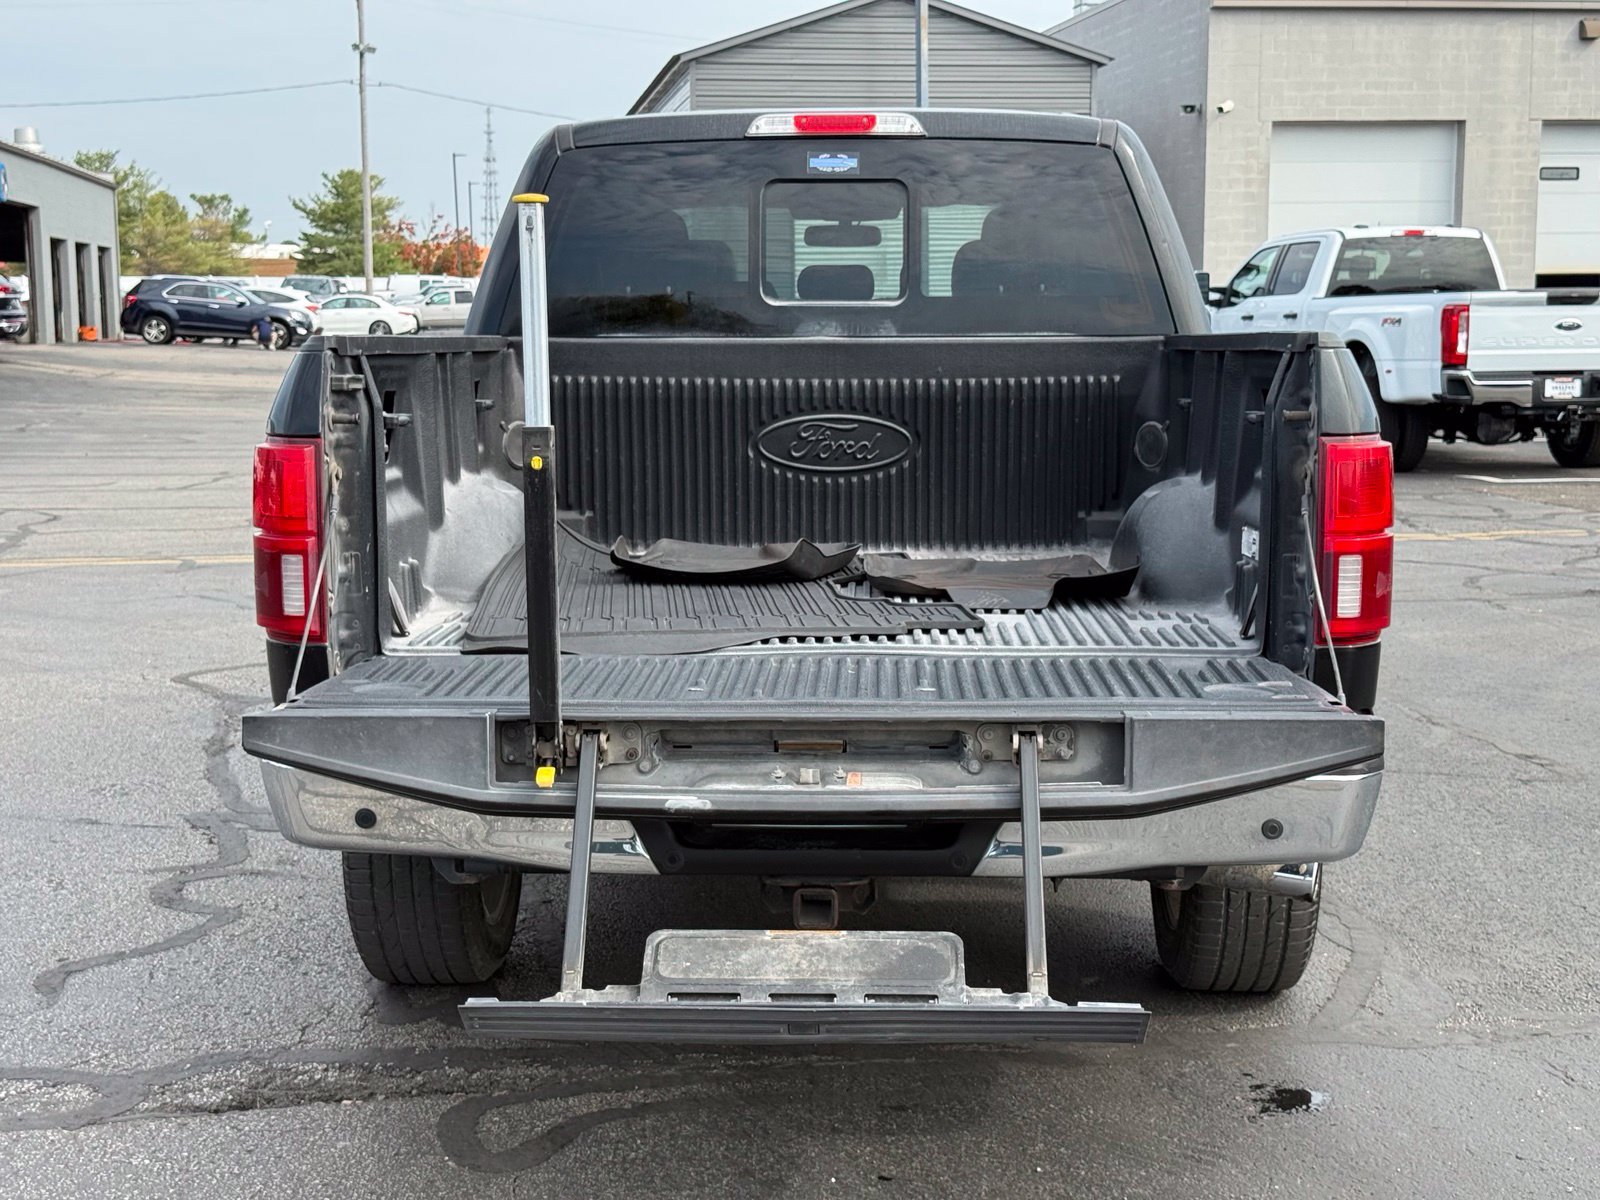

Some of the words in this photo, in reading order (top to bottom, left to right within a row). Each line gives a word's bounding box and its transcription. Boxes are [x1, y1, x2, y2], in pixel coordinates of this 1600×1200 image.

[1381, 317, 1402, 327] FX4
[1480, 335, 1575, 346] SUPER
[790, 421, 882, 459] Ford
